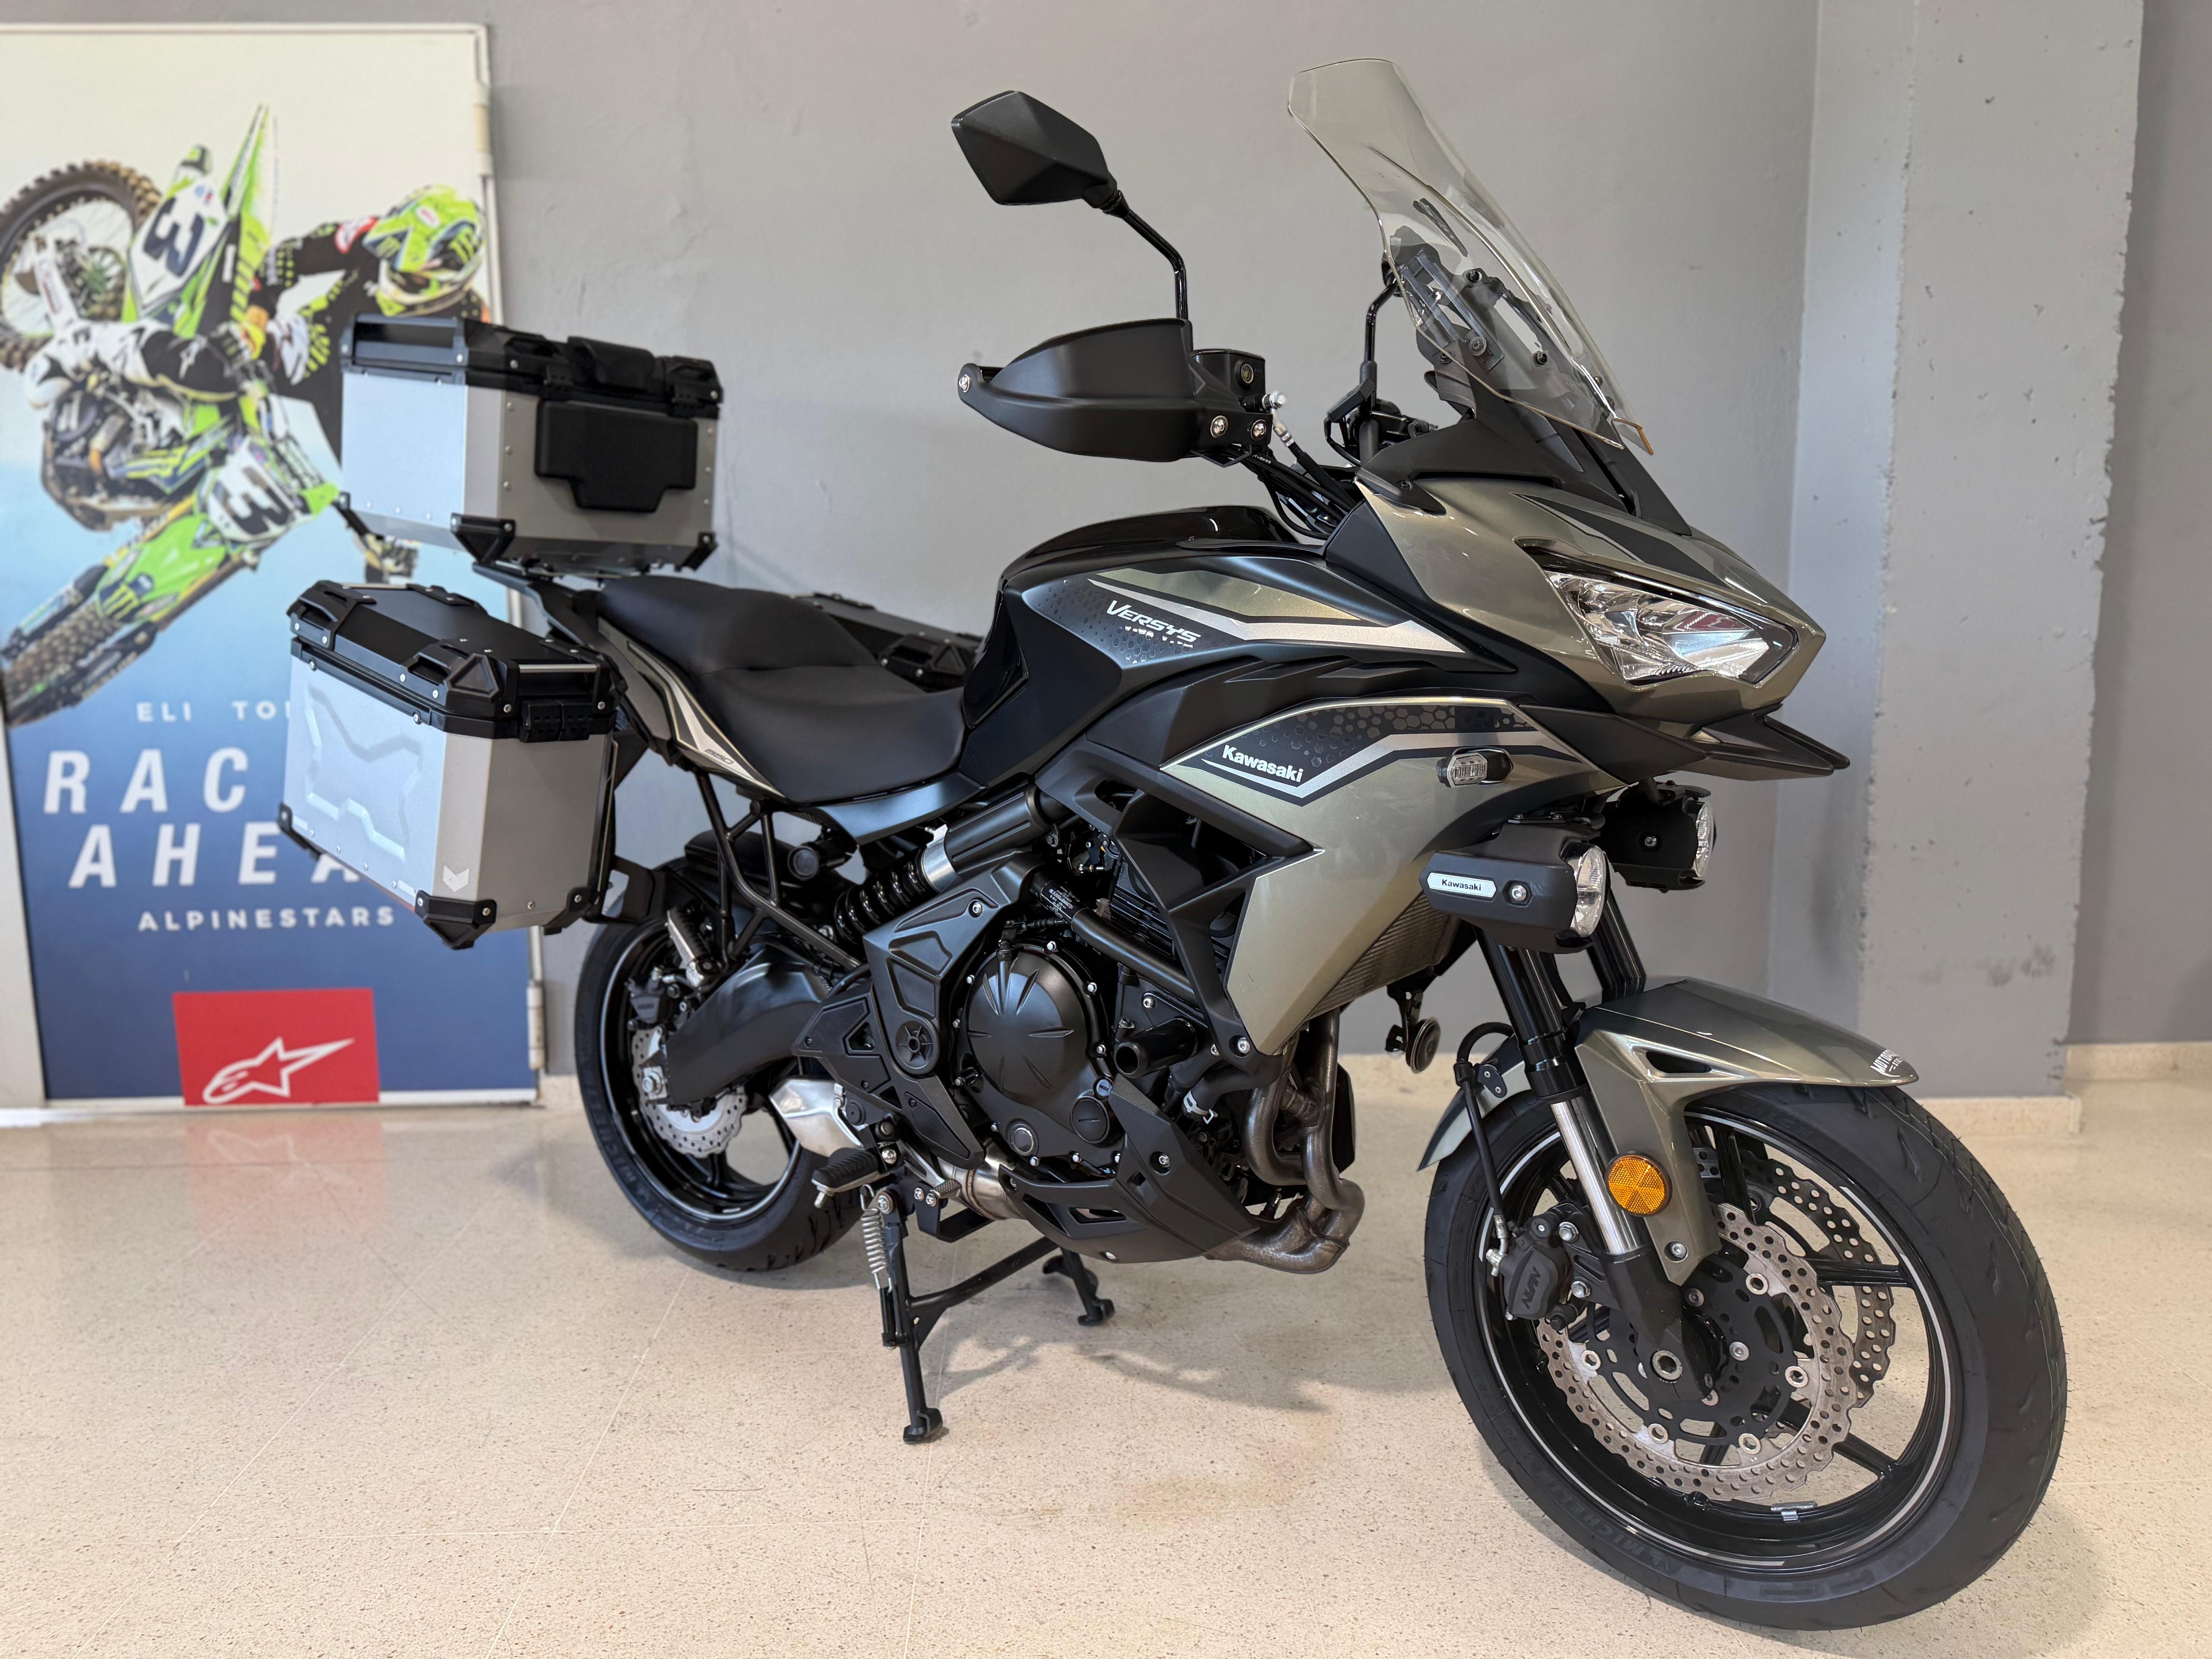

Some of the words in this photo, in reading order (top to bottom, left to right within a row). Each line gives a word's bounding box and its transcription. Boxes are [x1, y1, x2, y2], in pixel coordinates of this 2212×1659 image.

[137, 701, 191, 722] ELI
[232, 700, 290, 721] TO
[704, 749, 734, 764] 650
[1222, 744, 1304, 783] Kawasaki
[1442, 879, 1481, 891] Kawasaki
[138, 906, 394, 931] ALPINESTARS
[1535, 1468, 1645, 1557] MICHELIN
